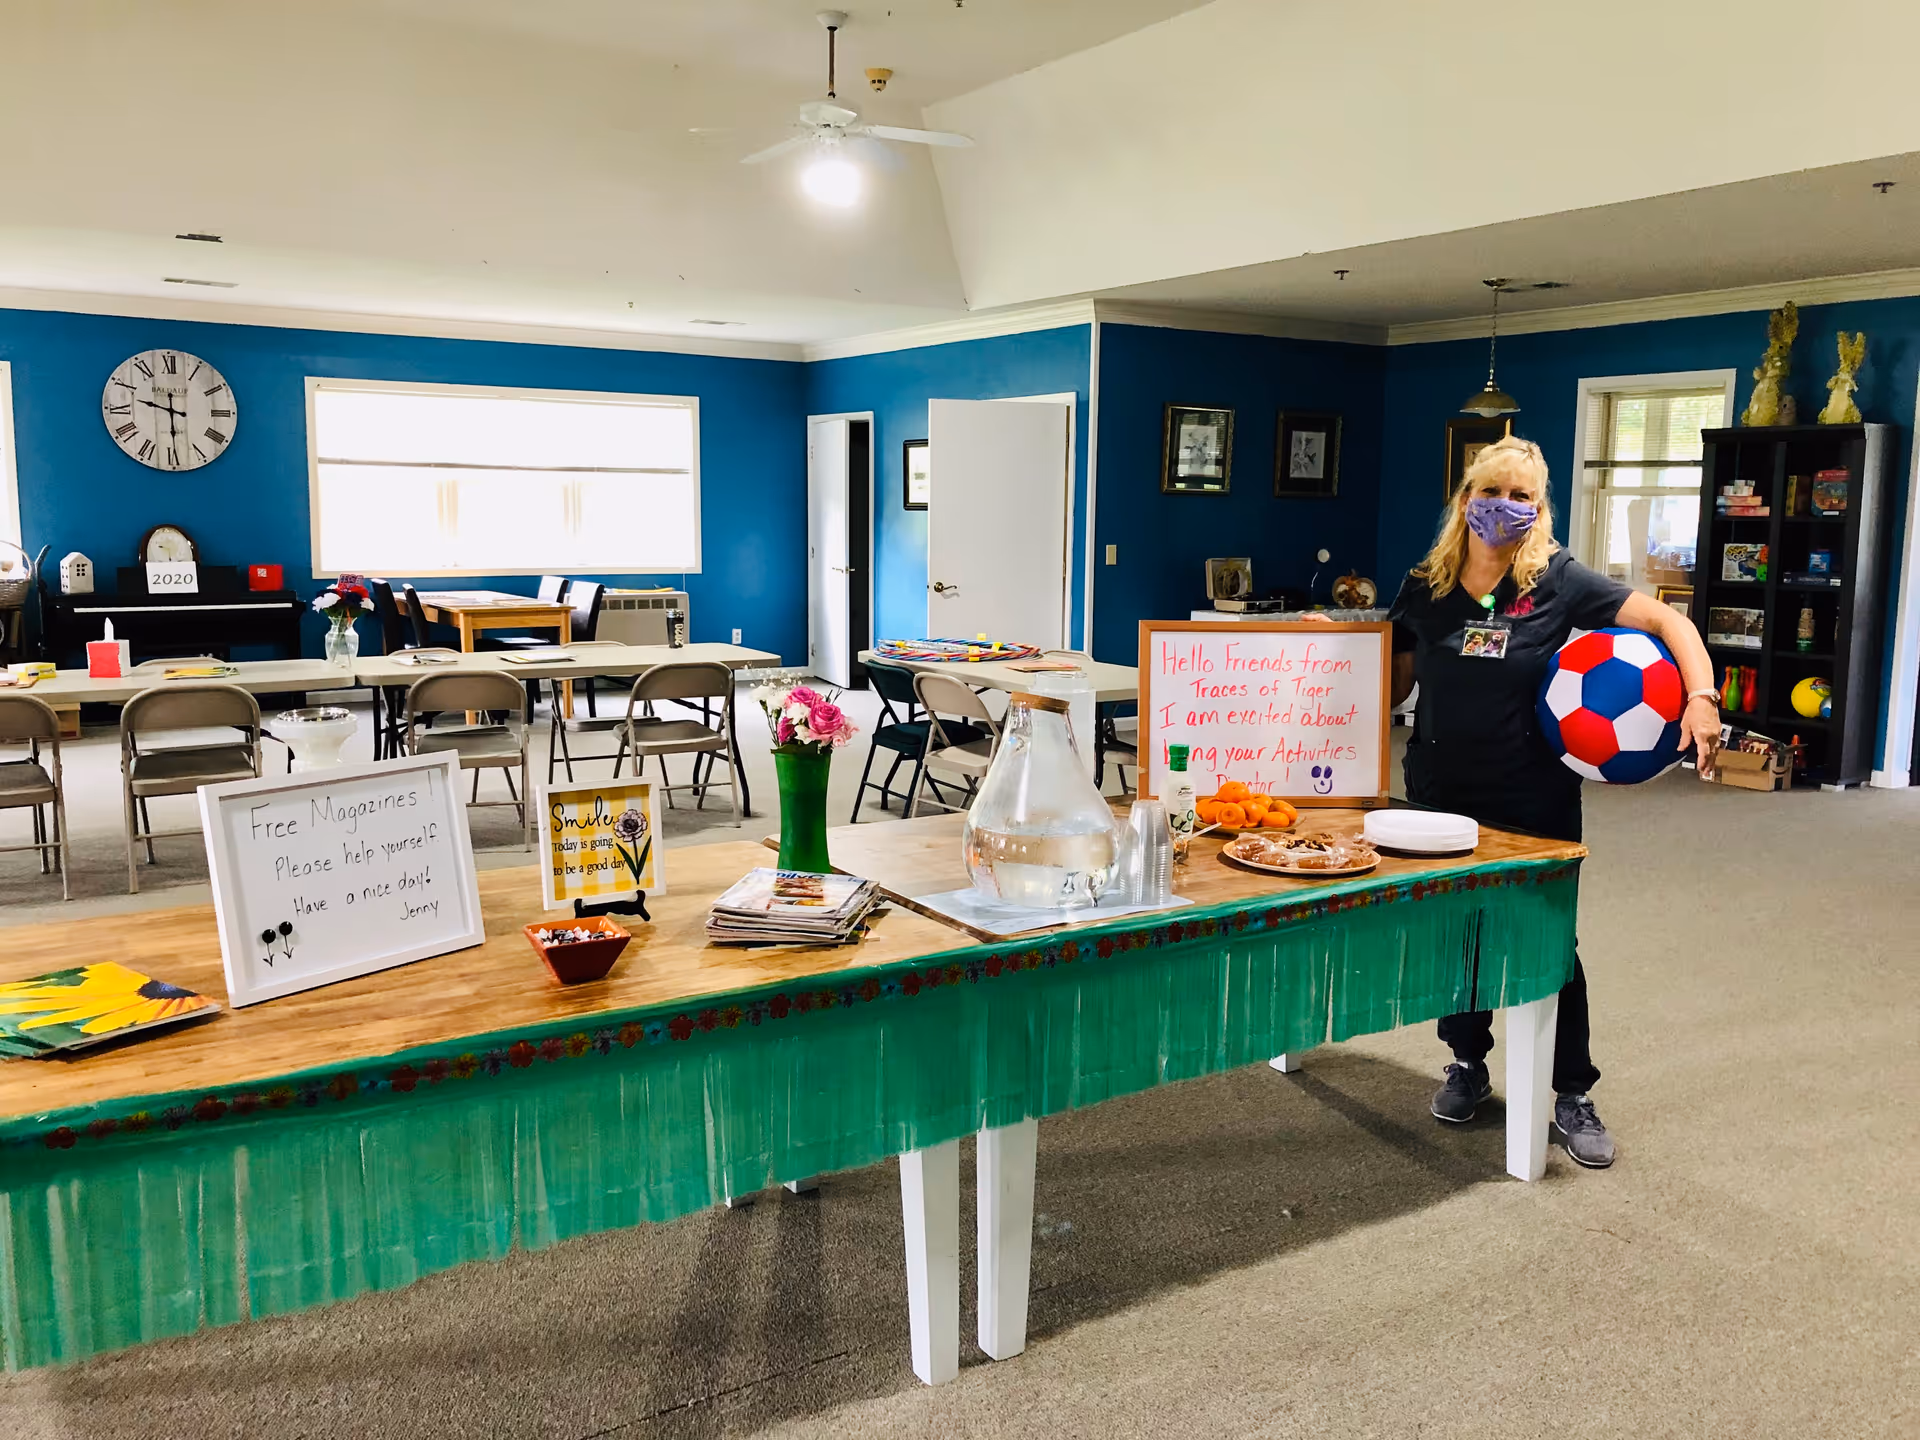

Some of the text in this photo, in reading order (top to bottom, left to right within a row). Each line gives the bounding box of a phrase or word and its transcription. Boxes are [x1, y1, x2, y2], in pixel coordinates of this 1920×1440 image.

[161, 355, 177, 375] XII
[114, 378, 138, 396] X
[203, 384, 222, 397] II
[109, 404, 131, 415] IX
[210, 409, 231, 418] III
[137, 439, 157, 461] VII
[166, 446, 180, 466] VI
[192, 443, 206, 461] V
[153, 574, 193, 584] 2020
[675, 623, 684, 646] 2020
[1162, 641, 1352, 675] Hello Friends from
[1189, 676, 1335, 710] Traces of Tiger
[1159, 702, 1359, 729] I am excited about
[1224, 746, 1268, 769] your
[1271, 737, 1357, 764] Activities
[250, 802, 298, 840] Free
[551, 795, 615, 832] Smile
[551, 836, 614, 853] Today is going
[276, 855, 333, 881] Please
[343, 841, 375, 866] help
[553, 856, 627, 876] to be a good day
[293, 866, 432, 917] Have a nice day!
[399, 899, 440, 921] Jenny
